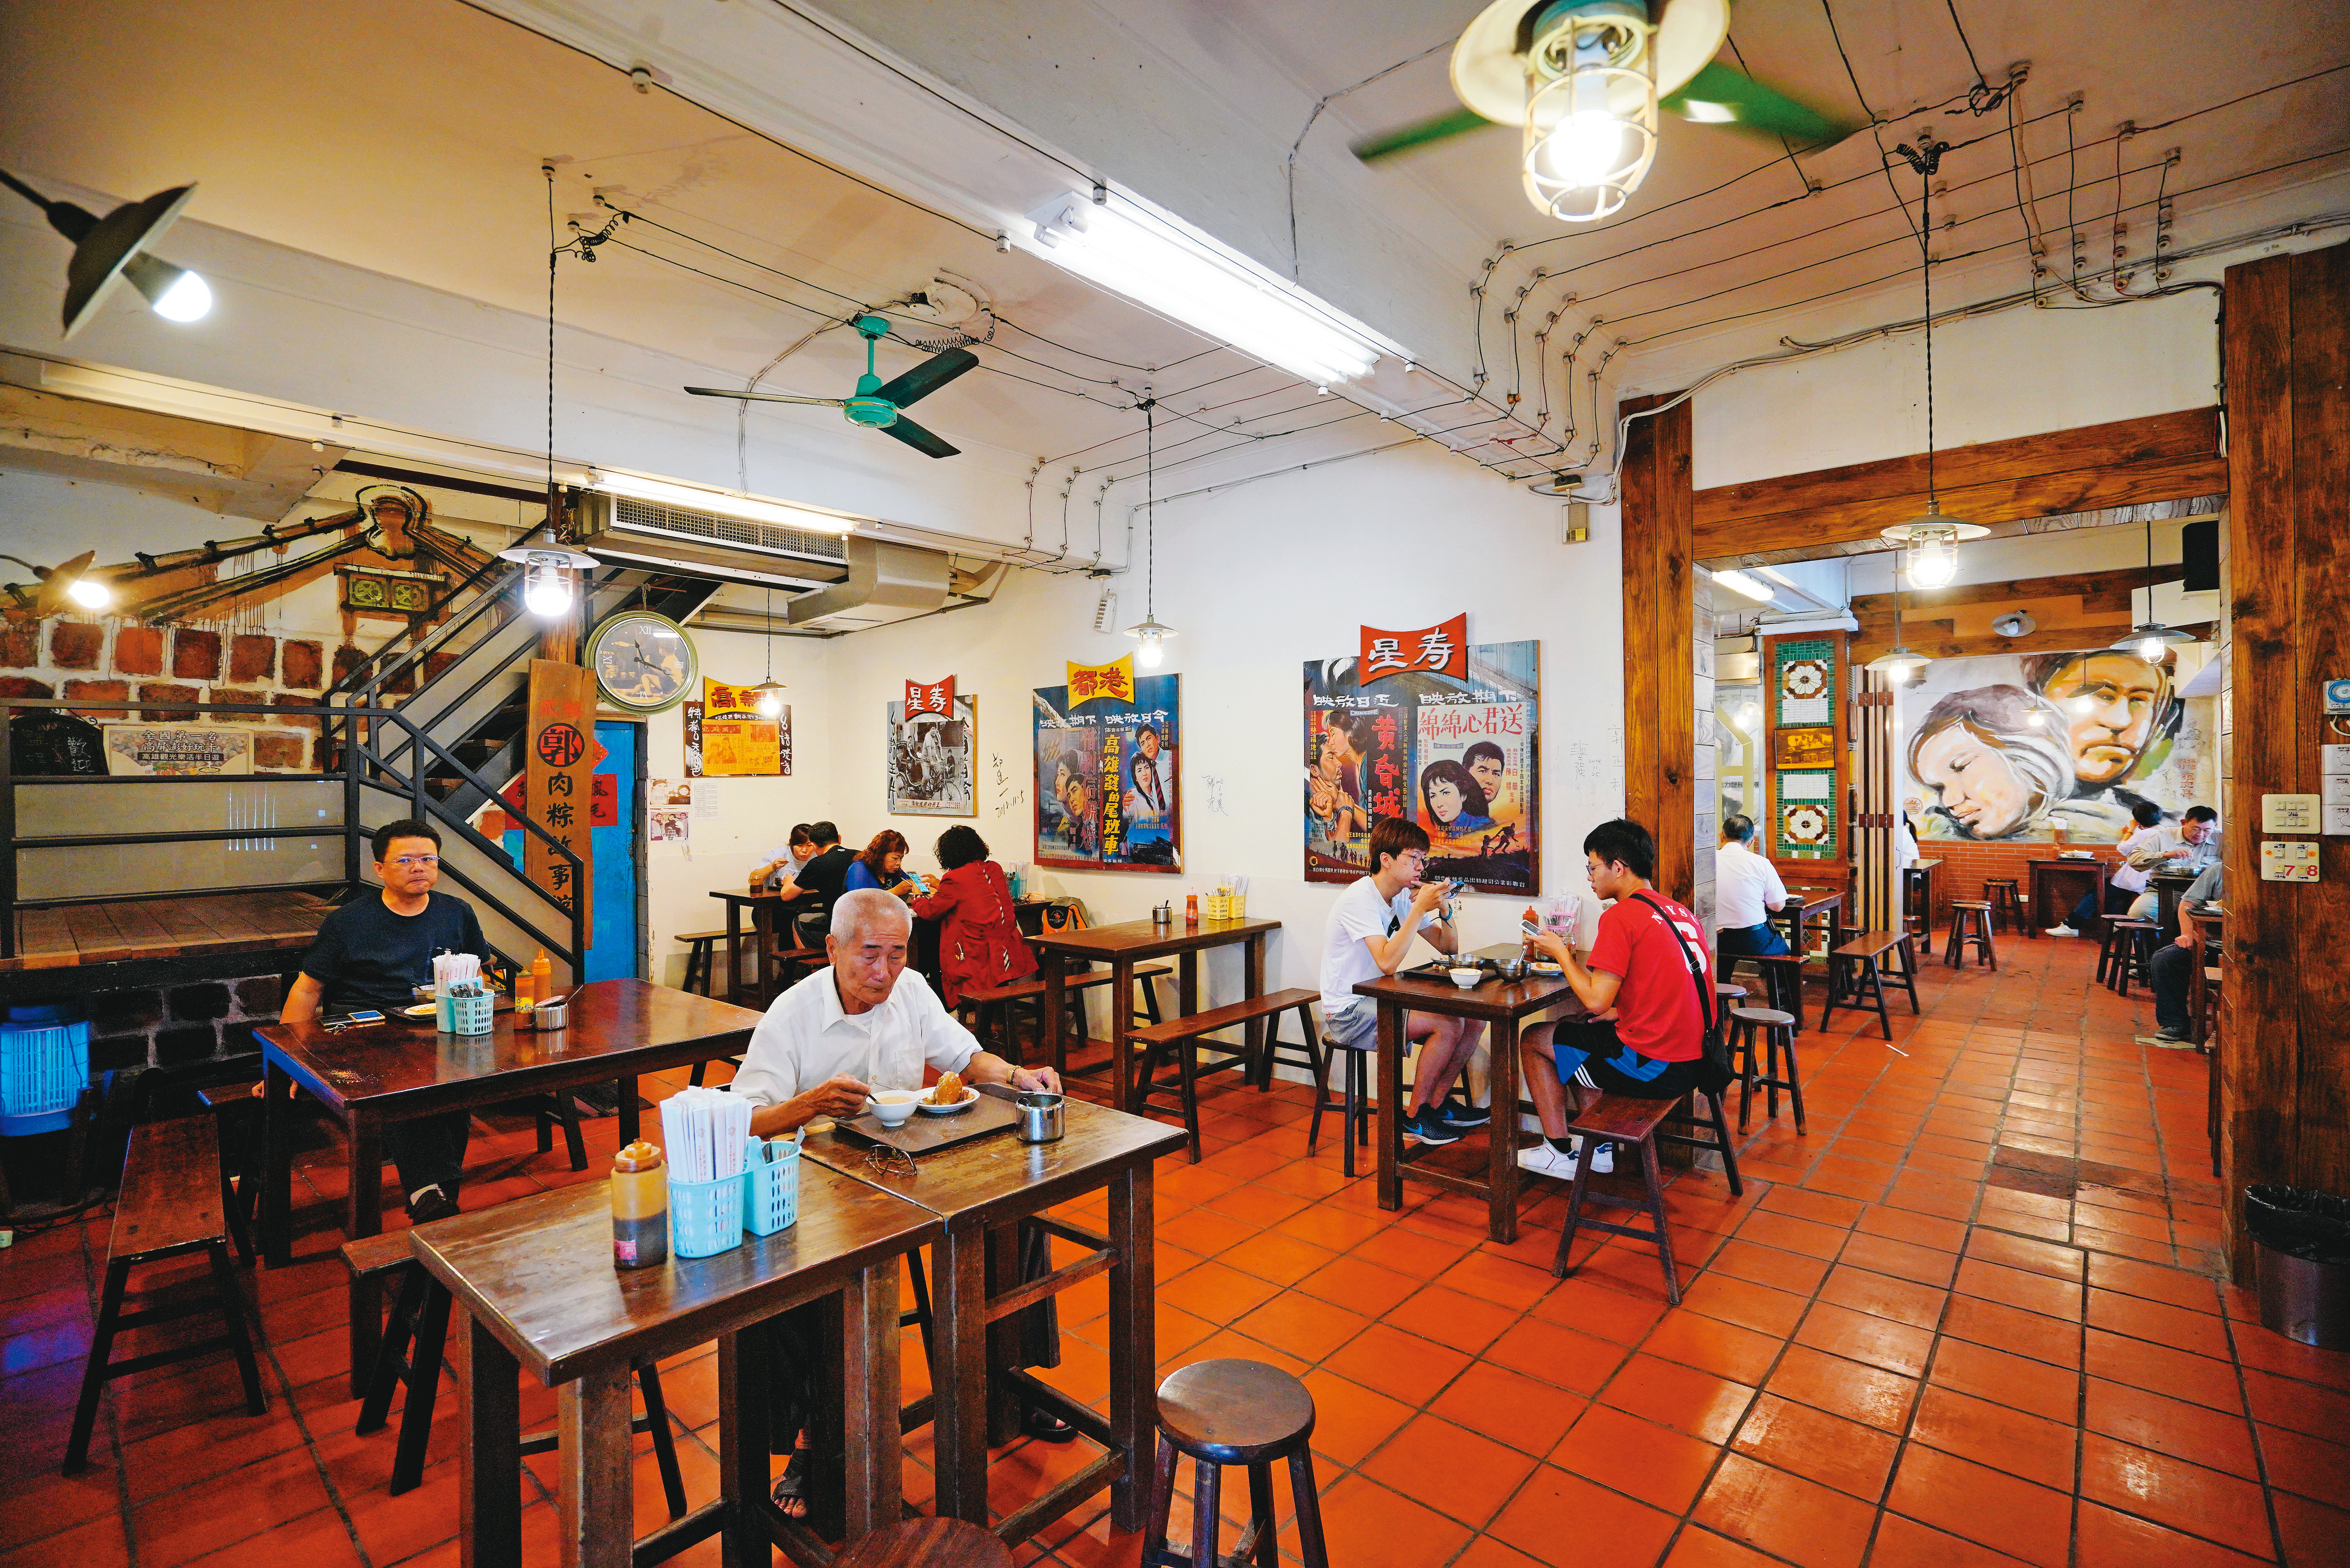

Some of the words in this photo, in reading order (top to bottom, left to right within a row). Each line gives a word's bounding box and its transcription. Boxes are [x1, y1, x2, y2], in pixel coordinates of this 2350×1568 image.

[142, 729, 217, 741] 全國第一名
[143, 741, 218, 752] 高屏澎好玩卡
[1103, 734, 1120, 855] 高雄發的尾班車
[2284, 864, 2295, 876] 7
[2307, 865, 2318, 876] 8
